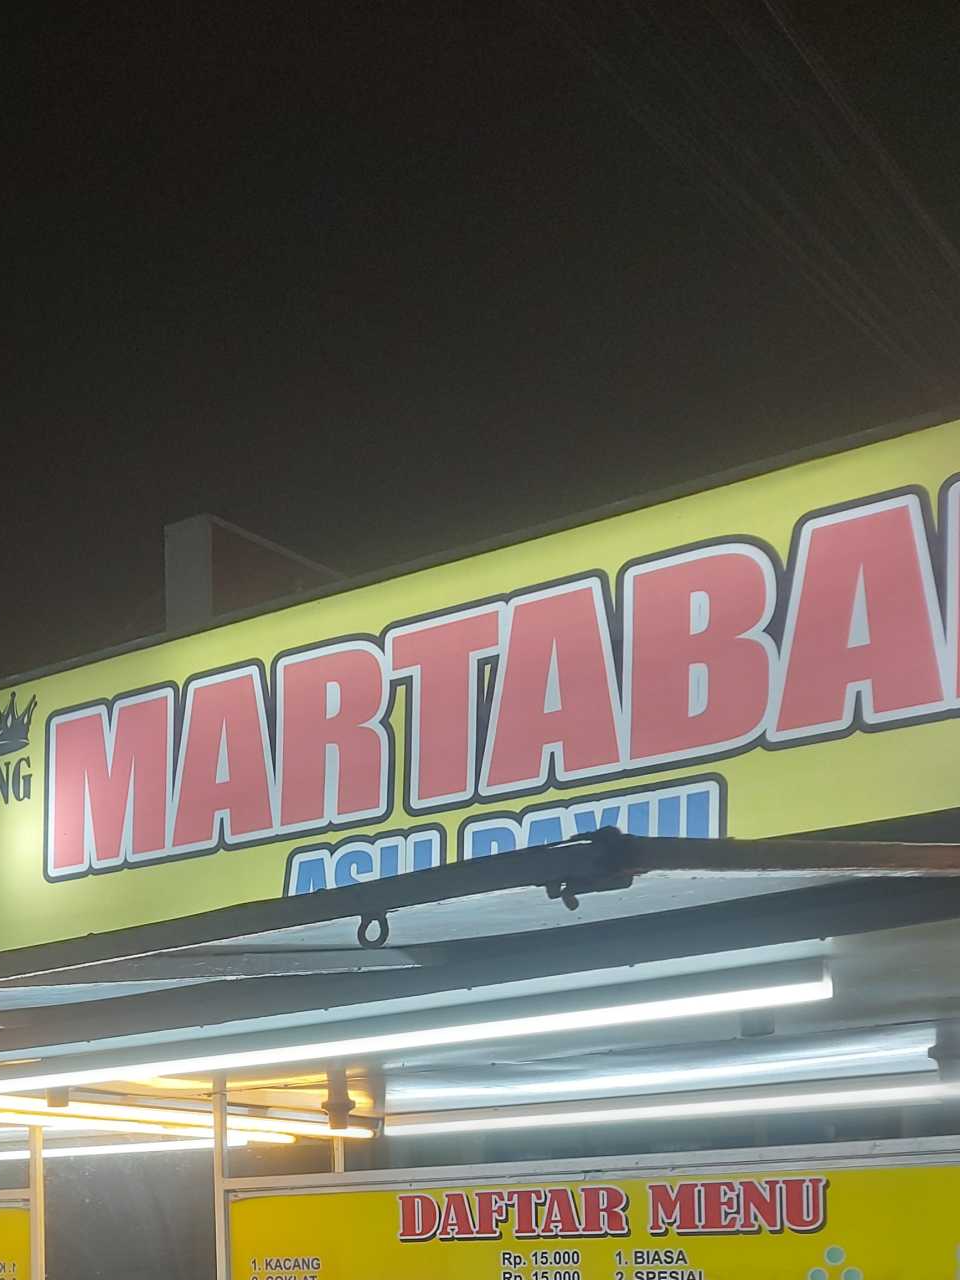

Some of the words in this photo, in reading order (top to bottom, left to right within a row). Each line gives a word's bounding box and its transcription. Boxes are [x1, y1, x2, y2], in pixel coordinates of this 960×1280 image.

[43, 472, 960, 882] MARTABA
[398, 1184, 631, 1242] DAFTAR
[647, 1176, 830, 1237] MENU
[251, 1258, 261, 1271] 1.
[264, 1257, 321, 1271] KACANG
[502, 1252, 527, 1268] Rp.
[531, 1251, 580, 1265] 15.000
[615, 1251, 628, 1265] 1.
[634, 1250, 688, 1265] BIASA
